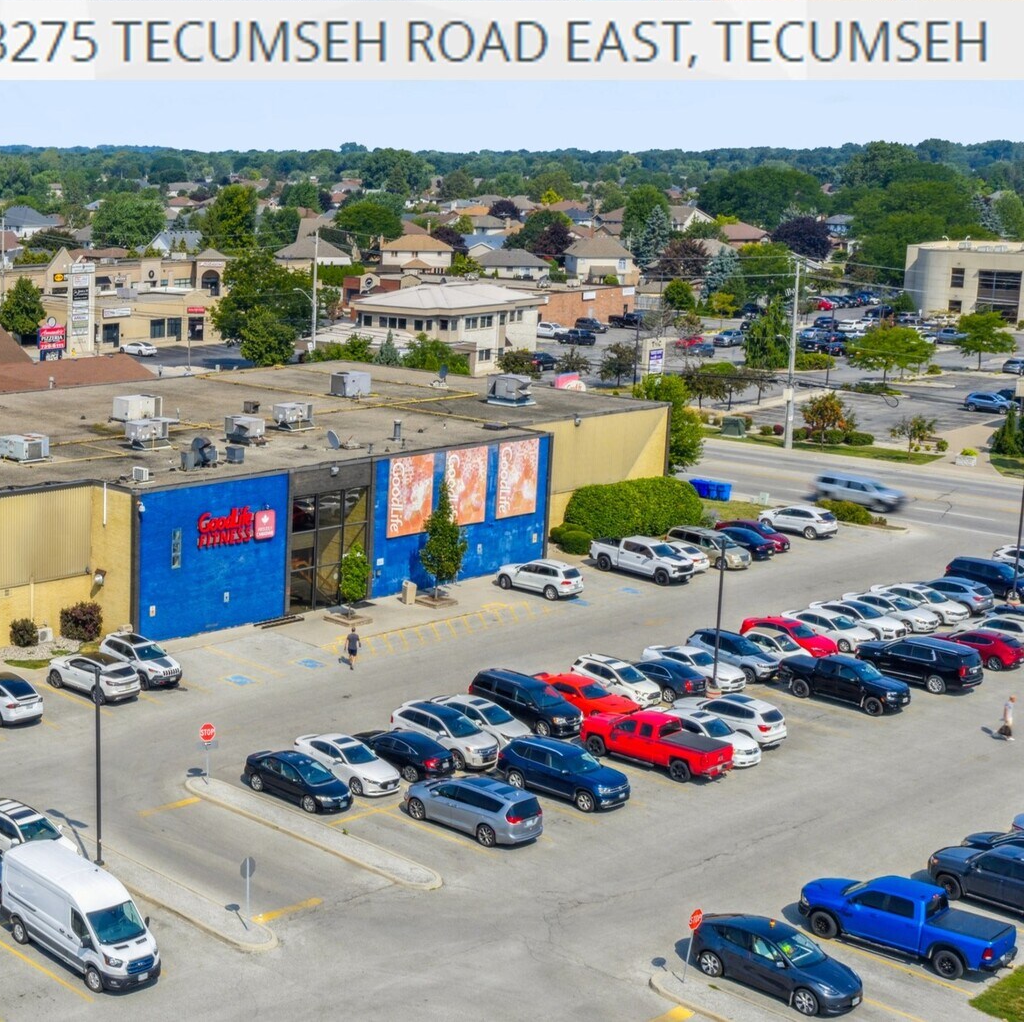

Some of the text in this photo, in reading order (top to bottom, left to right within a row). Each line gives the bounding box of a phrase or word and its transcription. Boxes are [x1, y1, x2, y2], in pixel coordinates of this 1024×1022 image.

[499, 446, 513, 513] GoodLife
[389, 462, 405, 533] GoodLife
[198, 505, 253, 533] GoodLife
[197, 527, 252, 549] FITNESS
[200, 728, 215, 736] STOP
